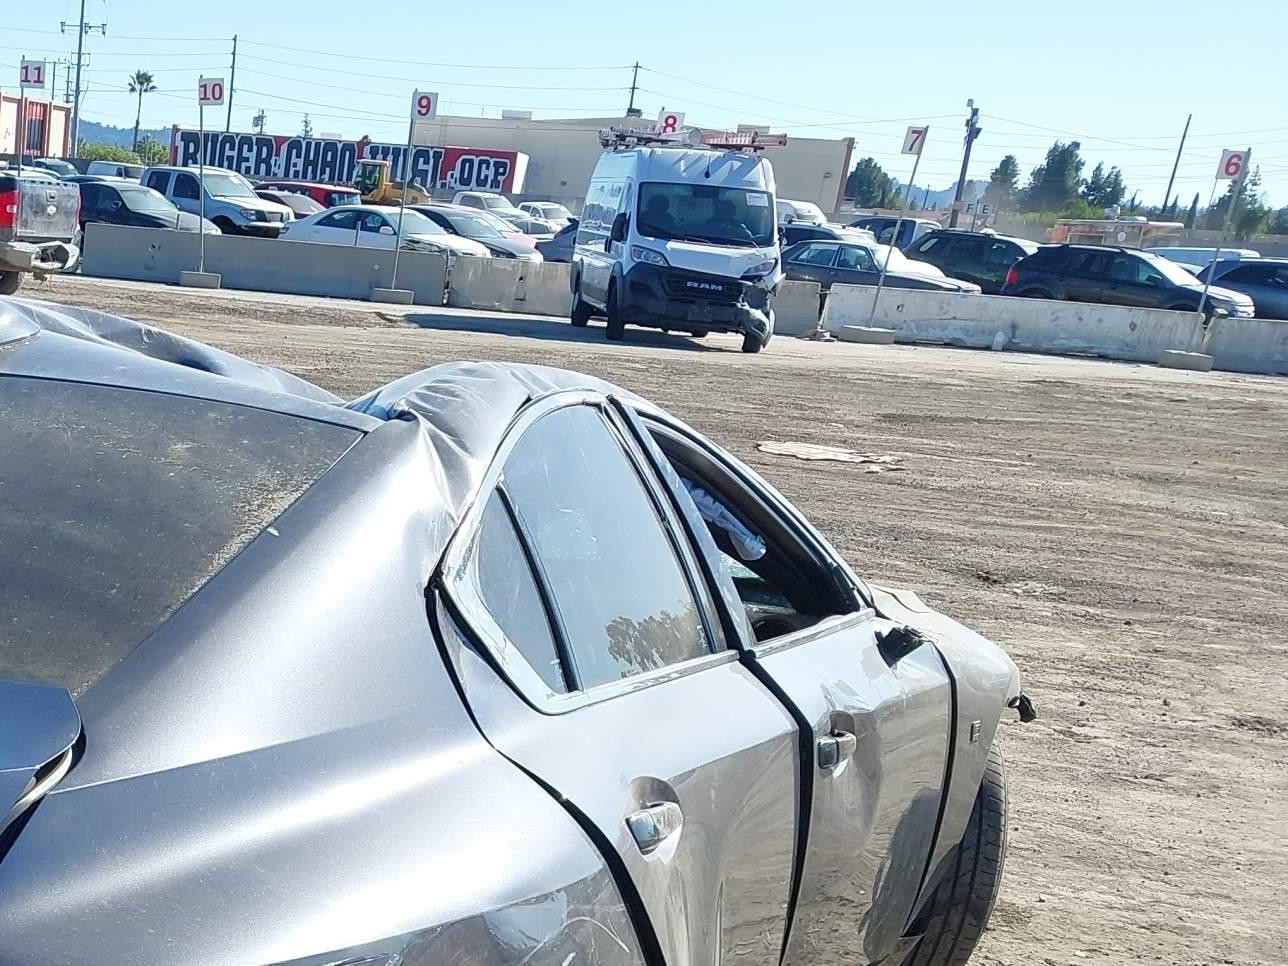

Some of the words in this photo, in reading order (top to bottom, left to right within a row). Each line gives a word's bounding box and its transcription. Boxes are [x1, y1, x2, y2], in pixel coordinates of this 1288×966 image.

[20, 64, 44, 84] 11
[199, 83, 223, 101] 10
[417, 95, 432, 117] 9
[663, 114, 678, 134] 8
[908, 129, 924, 152] 7
[1224, 153, 1242, 177] 6
[966, 203, 974, 213] F
[982, 204, 990, 215] E
[686, 281, 723, 291] RAM
